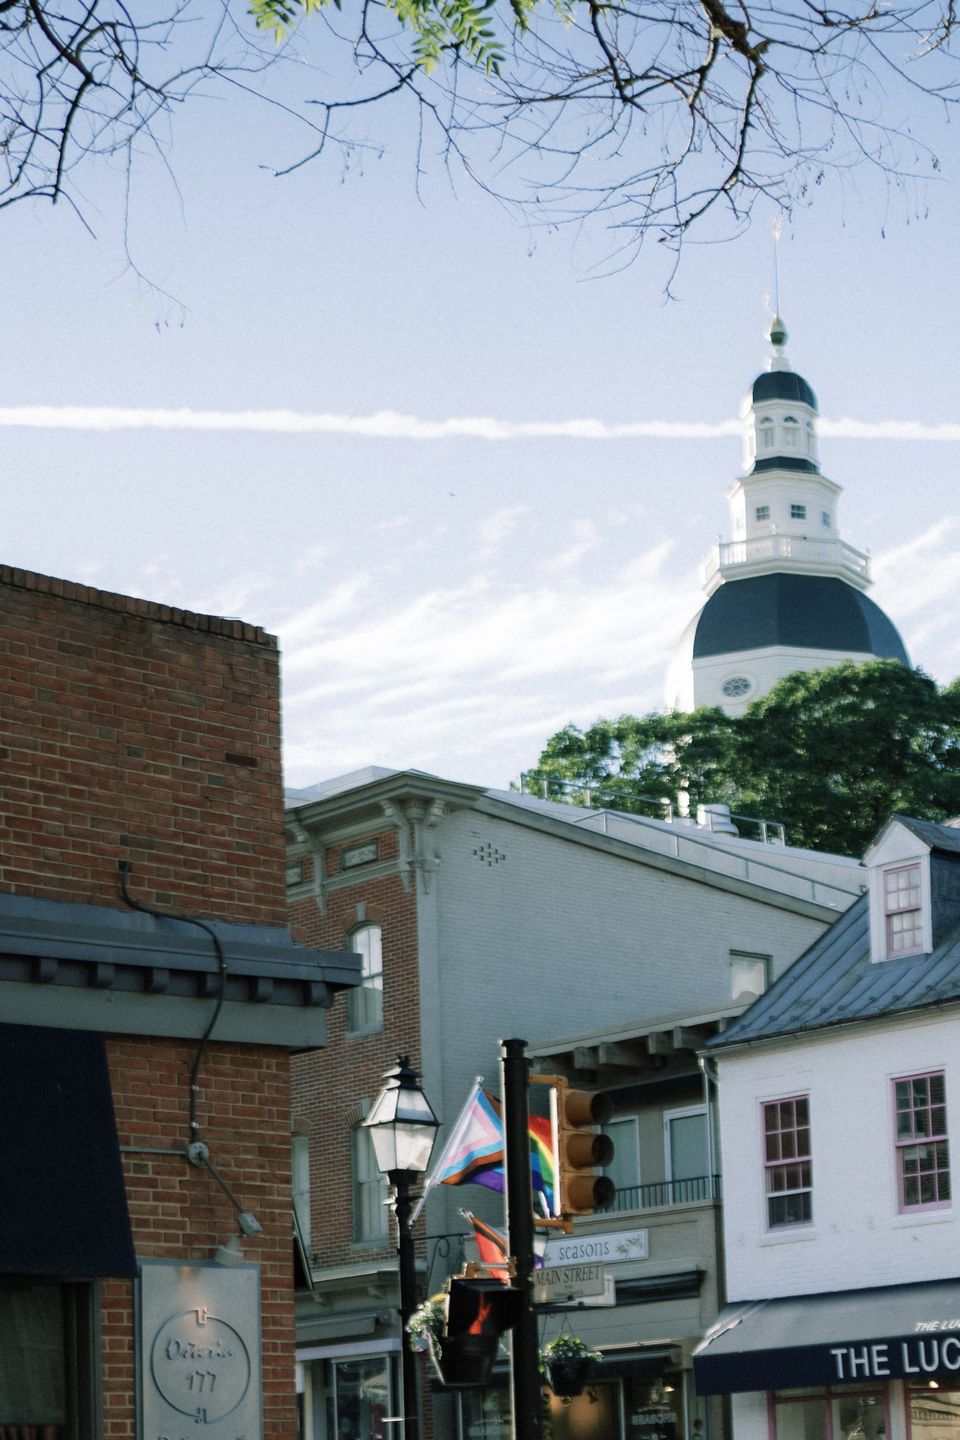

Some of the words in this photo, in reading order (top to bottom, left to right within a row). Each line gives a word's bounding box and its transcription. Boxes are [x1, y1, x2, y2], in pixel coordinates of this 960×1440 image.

[559, 1240, 610, 1261] seasons
[535, 1269, 562, 1287] MAIN
[562, 1265, 601, 1284] STREET
[914, 1320, 940, 1332] THE
[165, 1337, 235, 1361] Osteria
[831, 1344, 891, 1379] THE
[186, 1370, 217, 1393] 177
